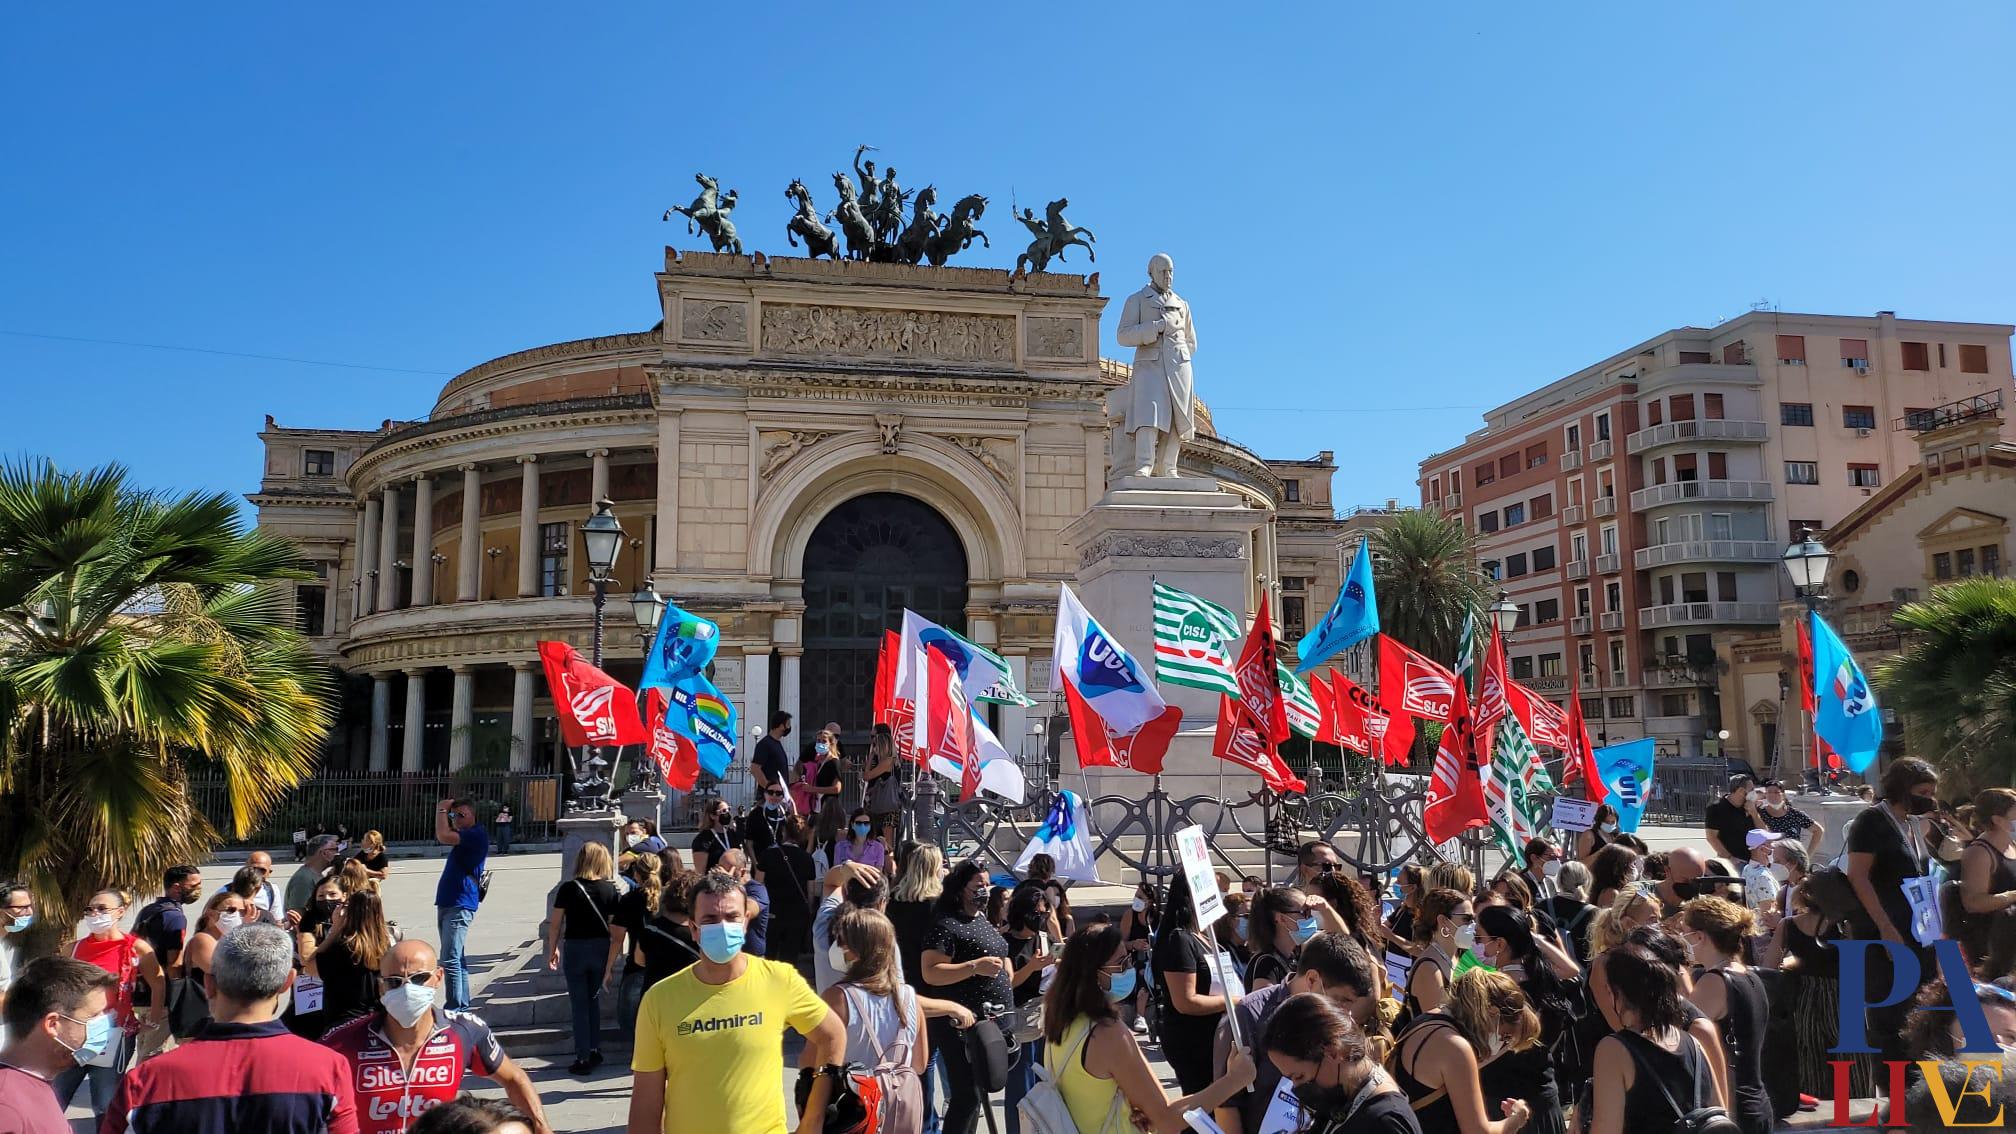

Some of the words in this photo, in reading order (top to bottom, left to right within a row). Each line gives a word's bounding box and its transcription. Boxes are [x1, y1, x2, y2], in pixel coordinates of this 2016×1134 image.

[804, 389, 884, 402] POLITEAMA
[898, 393, 970, 406] GARIBALDI
[1183, 624, 1207, 639] CISL
[674, 690, 688, 704] UIL
[1422, 699, 1450, 717] SLC
[1618, 775, 1638, 809] UIL
[691, 1012, 763, 1034] Admiral
[361, 1064, 450, 1090] Silence
